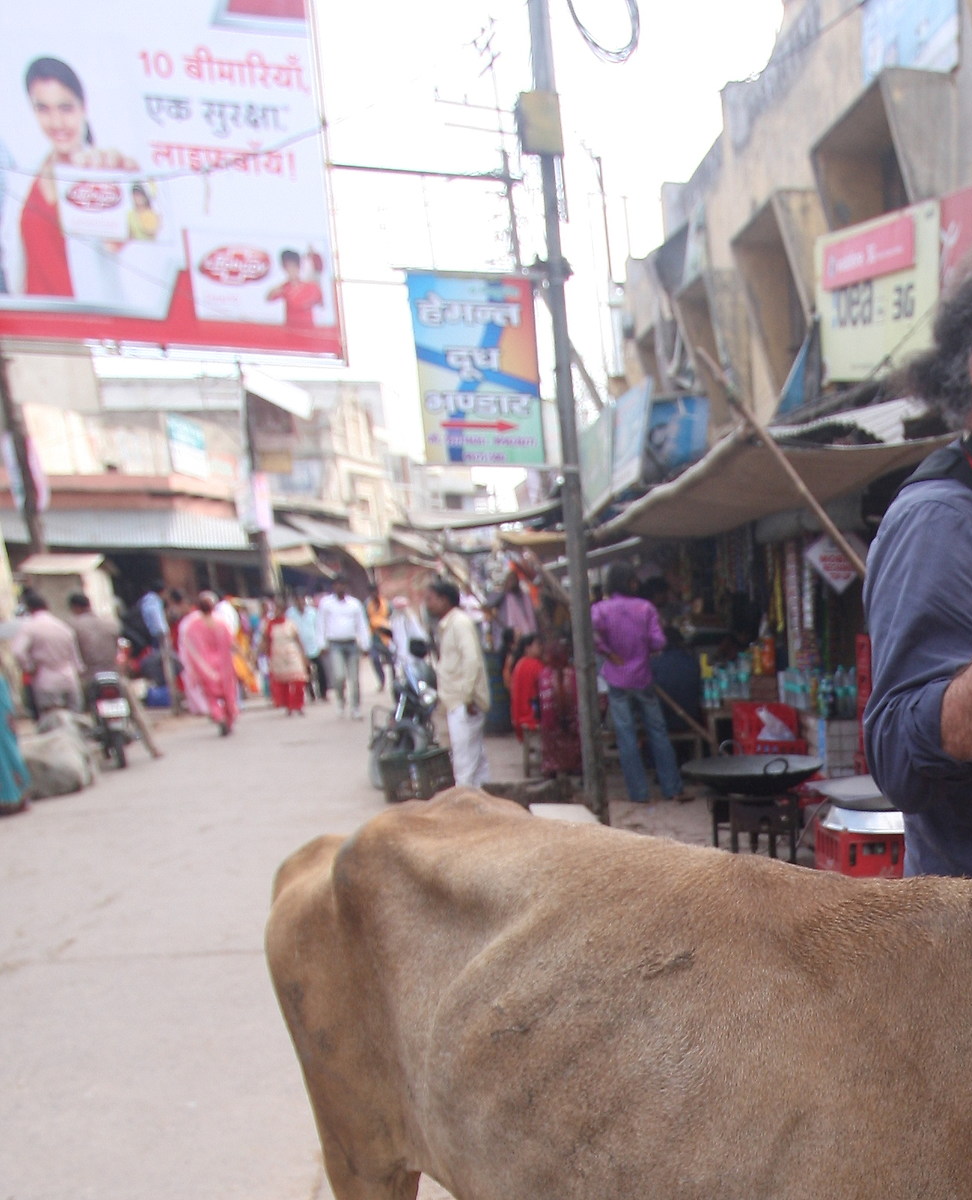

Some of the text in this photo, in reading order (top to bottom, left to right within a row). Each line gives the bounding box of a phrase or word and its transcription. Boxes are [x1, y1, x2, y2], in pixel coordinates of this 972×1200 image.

[139, 50, 173, 79] 10
[144, 95, 192, 127] एक
[444, 346, 502, 383] दूध
[424, 391, 535, 419] भण्डार
